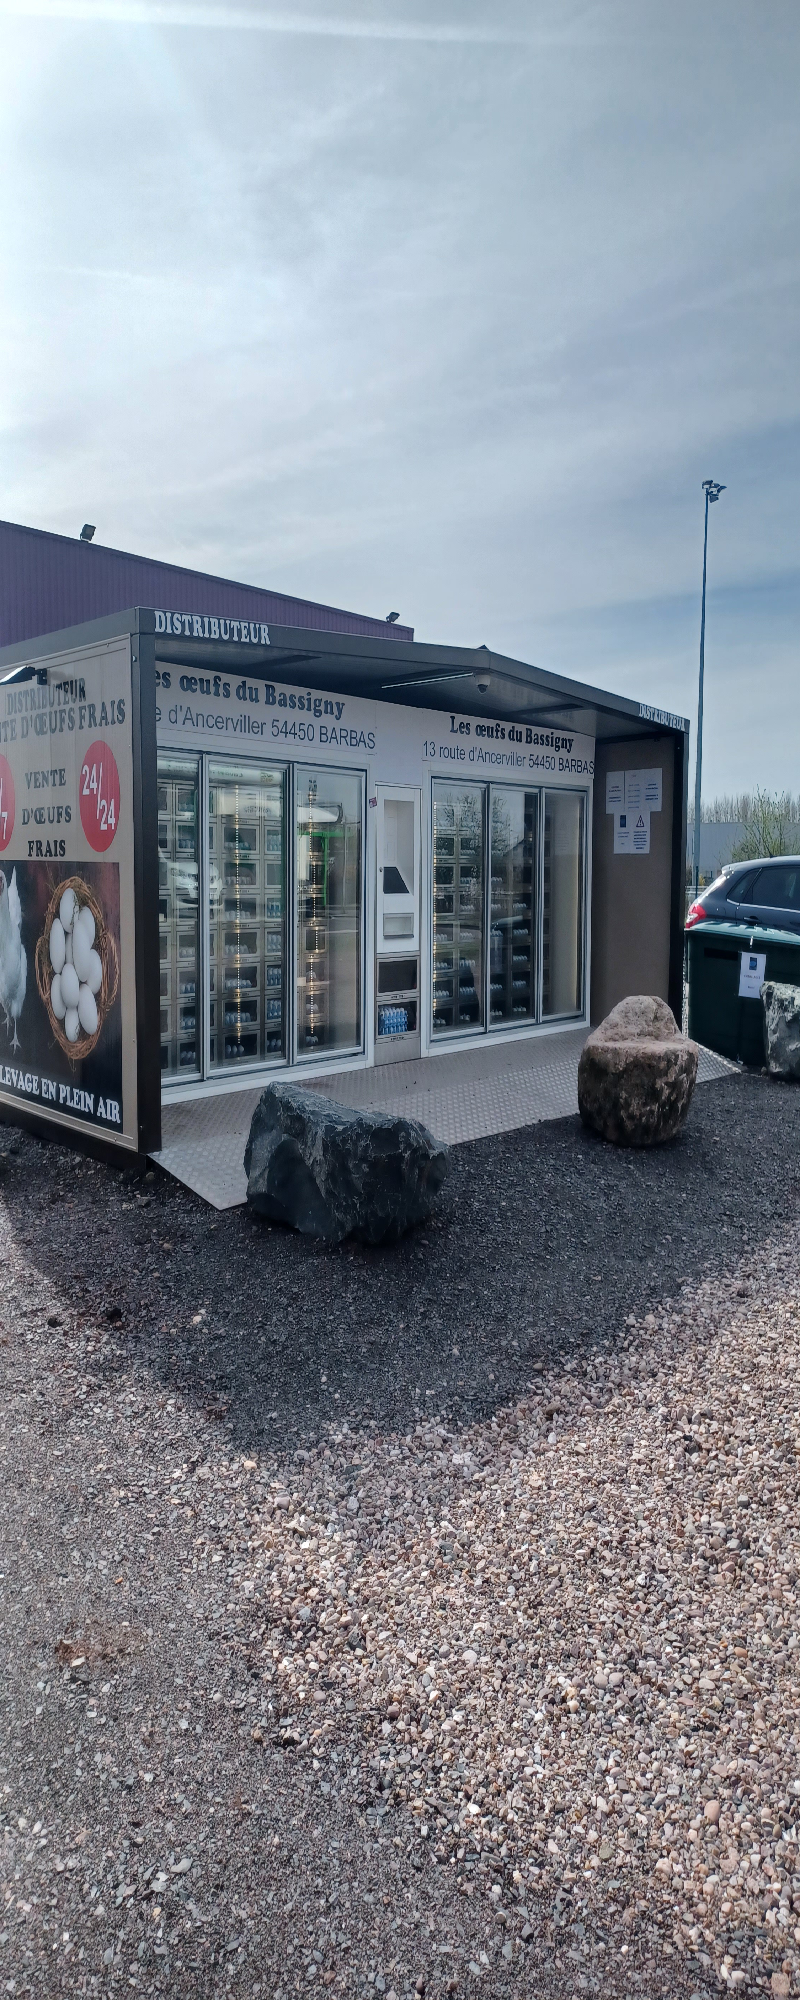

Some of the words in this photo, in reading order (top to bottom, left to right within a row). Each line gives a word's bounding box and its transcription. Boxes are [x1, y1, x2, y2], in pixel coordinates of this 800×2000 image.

[154, 611, 270, 644] DISTRIBUTEUR
[6, 677, 86, 715] DISTRIBUTEUR
[155, 670, 171, 688] es
[179, 675, 231, 698] œufs
[236, 681, 260, 702] du
[265, 684, 345, 720] Bassigny
[78, 698, 126, 730] FRAIS
[168, 704, 266, 736] d'Ancerviller
[271, 719, 315, 743] 54450
[319, 726, 376, 749] BARBAS
[639, 703, 685, 731] DISTRIBUTEUR
[450, 716, 471, 735] Les
[475, 722, 505, 741] œufs
[508, 726, 523, 743] du
[525, 728, 574, 753] Bassigny
[423, 741, 436, 757] 13
[439, 745, 466, 760] route
[468, 747, 527, 767] d'Ancerviller
[528, 754, 556, 771] 54450
[558, 758, 595, 774] BARBAS
[25, 768, 66, 789] VENTE
[22, 805, 72, 825] D'ŒUFS
[28, 840, 66, 857] FRAIS
[0, 1065, 39, 1095] LEVAGE
[41, 1078, 57, 1100] EN
[59, 1084, 94, 1114] PLEIN
[97, 1097, 121, 1123] AIR
